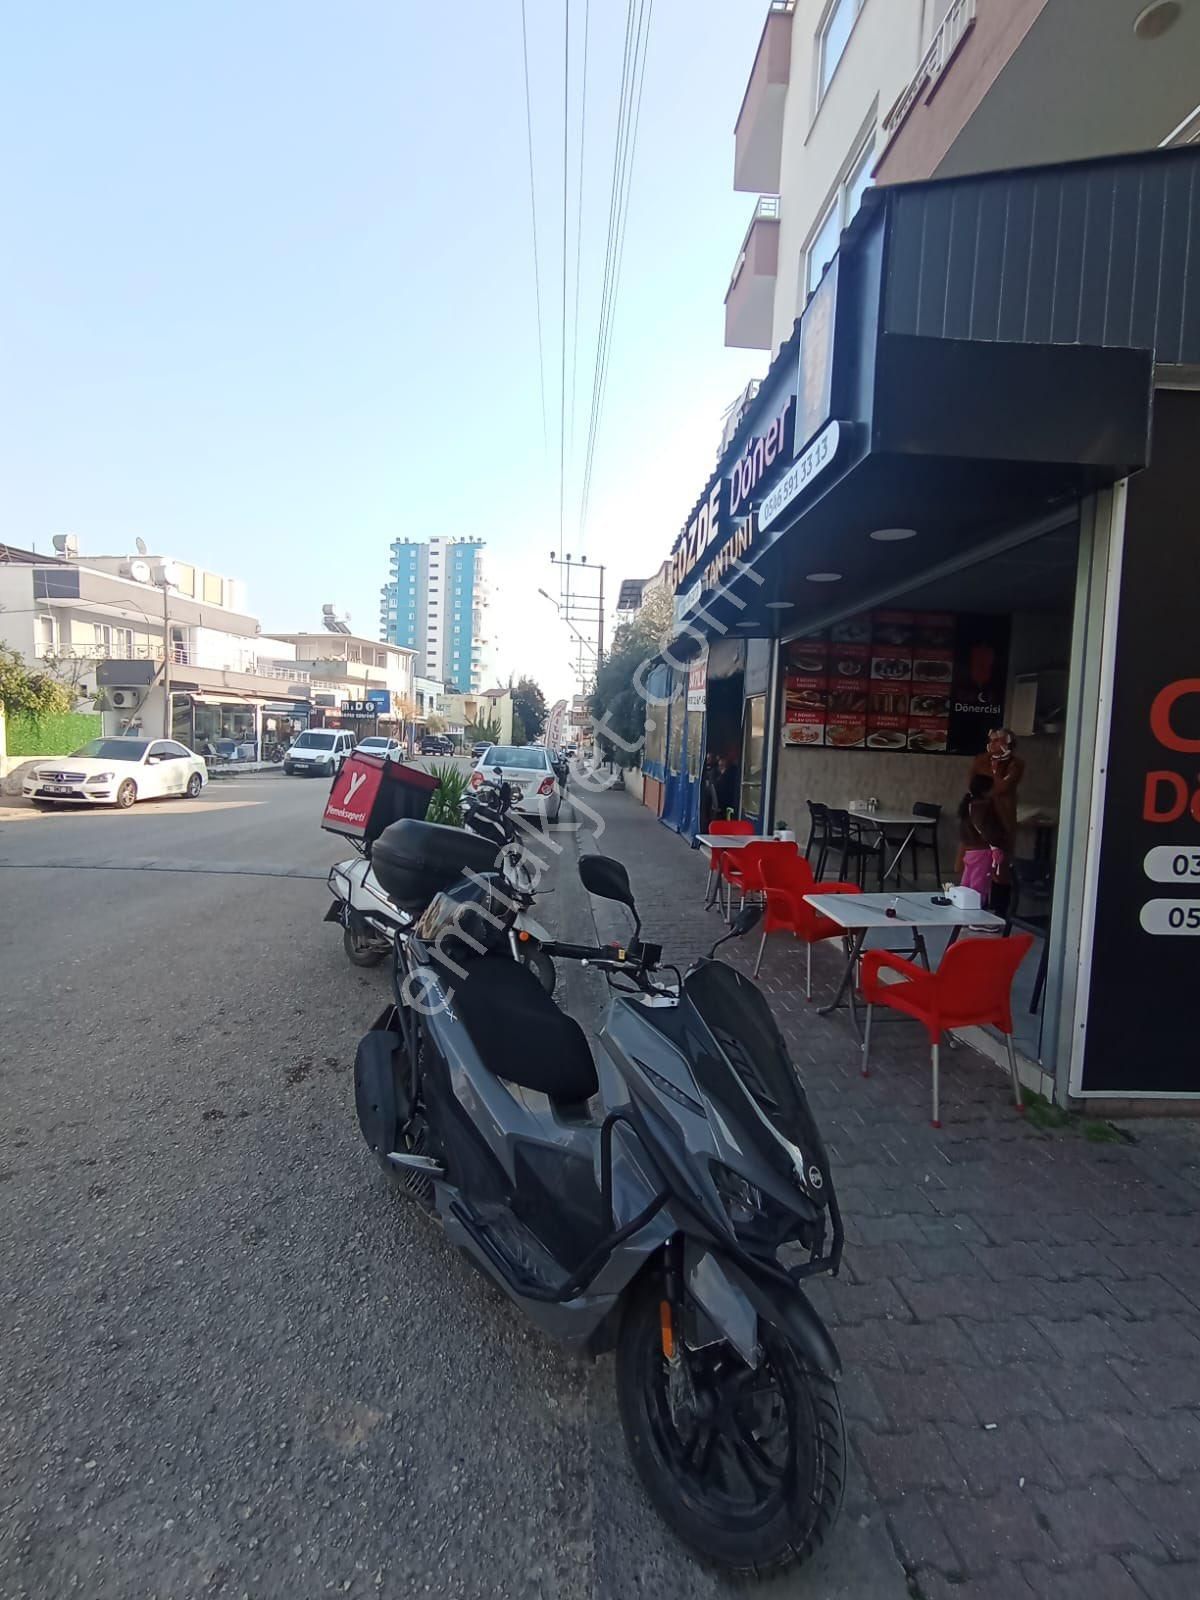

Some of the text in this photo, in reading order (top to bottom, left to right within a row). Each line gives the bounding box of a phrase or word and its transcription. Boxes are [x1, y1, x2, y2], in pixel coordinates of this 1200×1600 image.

[730, 400, 791, 516] Döner
[783, 470, 799, 496] 591
[801, 454, 813, 482] 33
[815, 436, 829, 467] 13
[955, 702, 1001, 714] Dönercisi
[343, 771, 367, 805] Y
[326, 804, 367, 823] Yemeksepeti
[1168, 907, 1200, 929] 05
